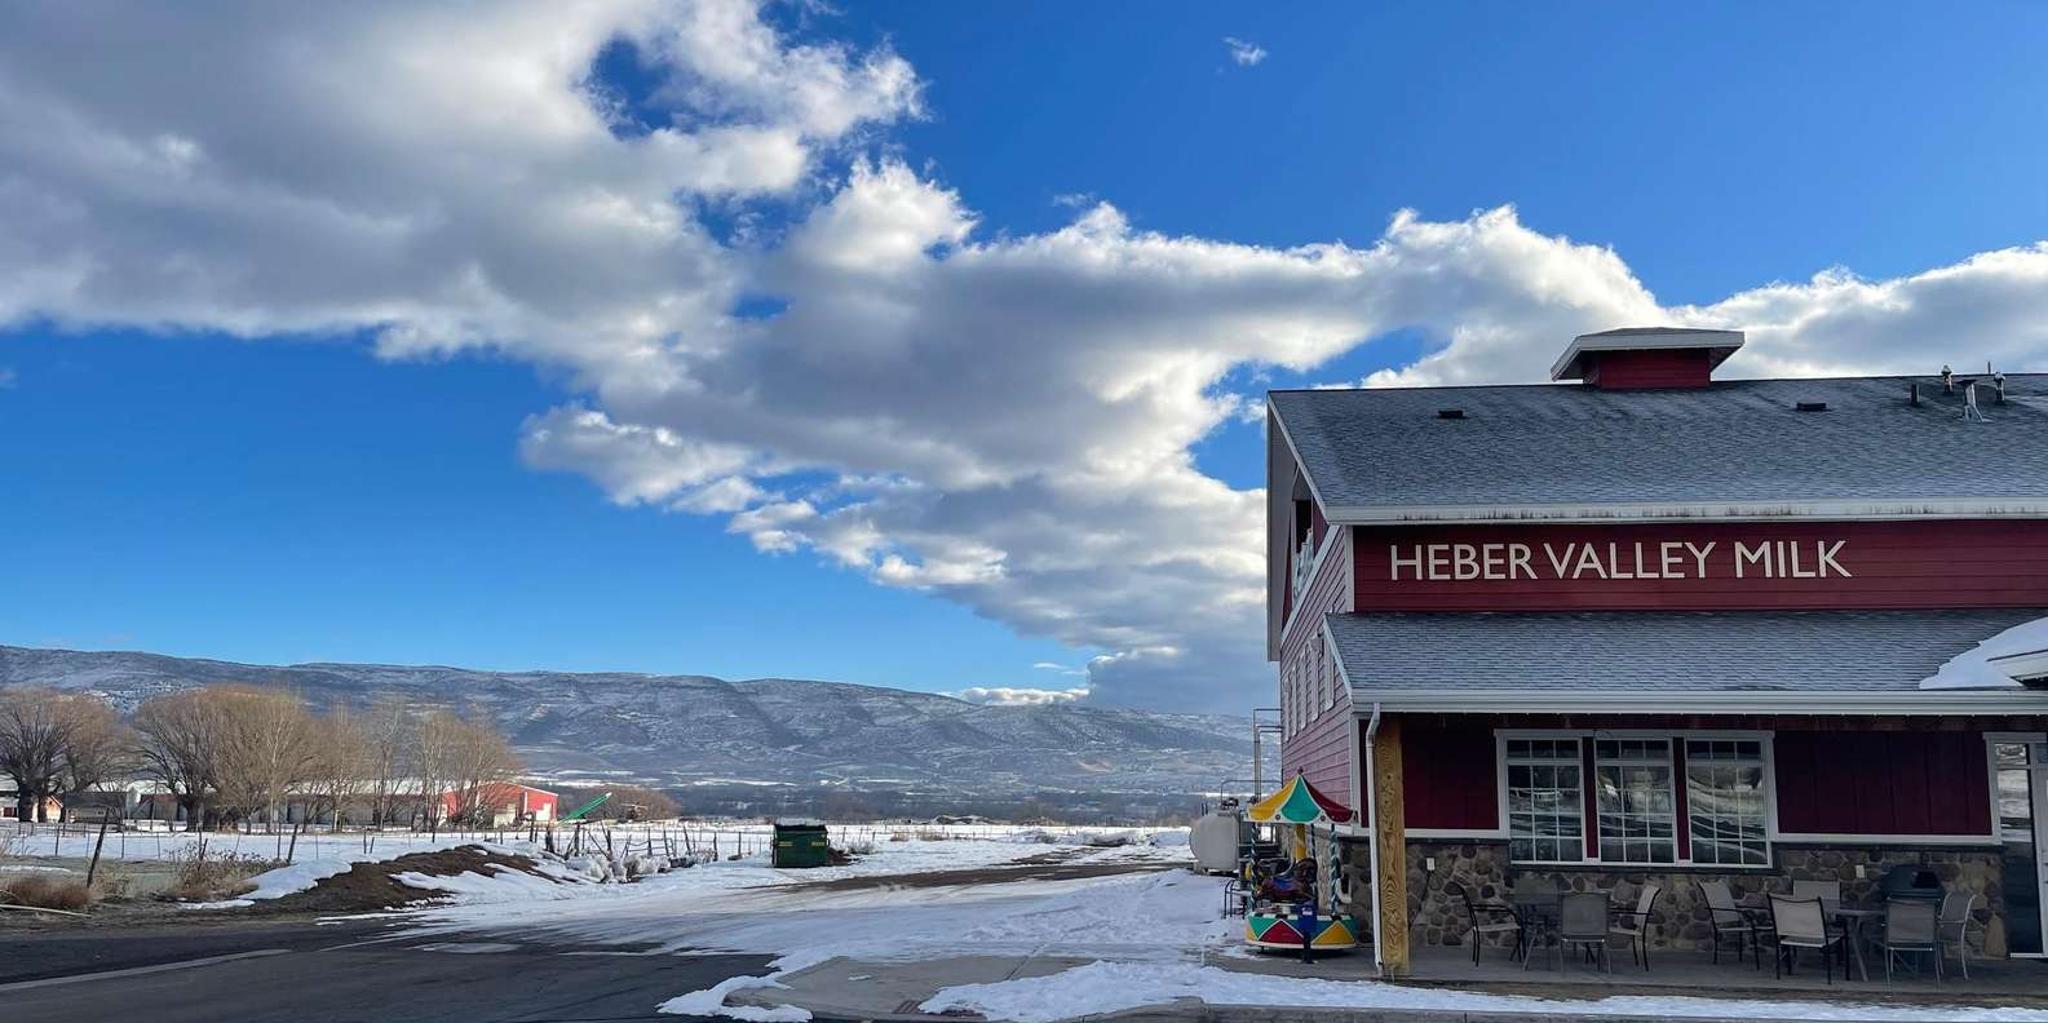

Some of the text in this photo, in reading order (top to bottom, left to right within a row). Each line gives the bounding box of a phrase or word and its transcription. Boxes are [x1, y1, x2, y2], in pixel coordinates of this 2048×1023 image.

[1390, 540, 1852, 580] HEBER VALLEY MILK
